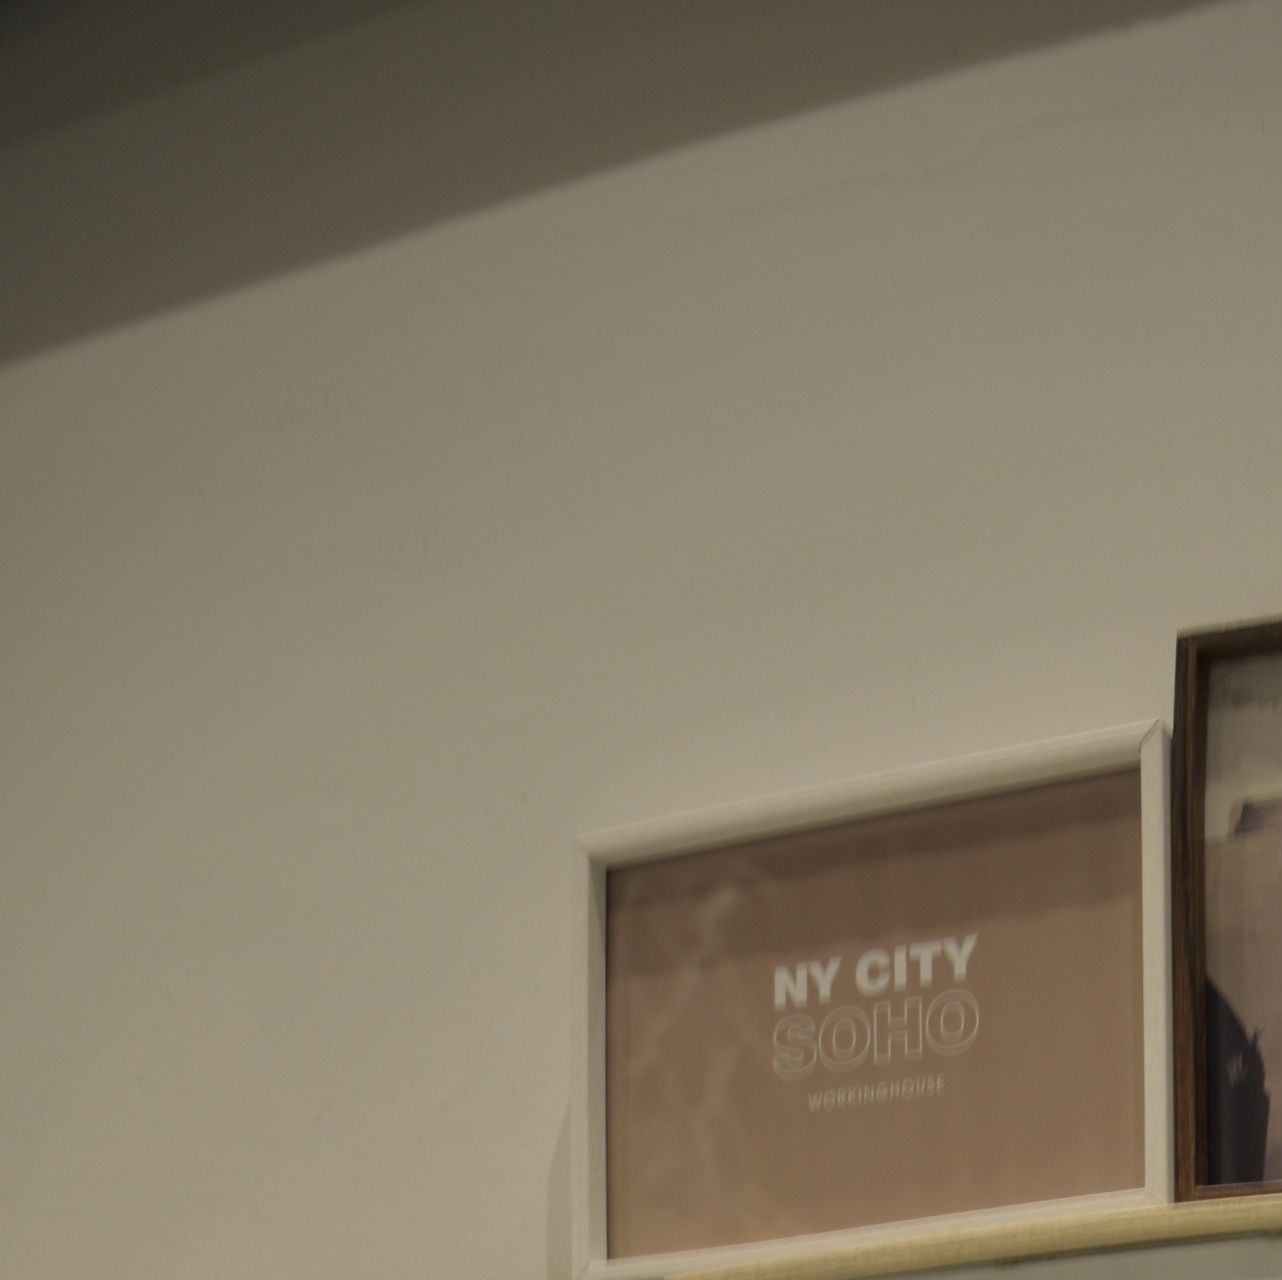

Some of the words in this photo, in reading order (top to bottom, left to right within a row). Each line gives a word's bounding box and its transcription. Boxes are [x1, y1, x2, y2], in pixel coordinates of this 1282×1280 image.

[774, 956, 842, 1011] NY
[855, 932, 978, 997] CITY
[772, 988, 980, 1080] SOHO
